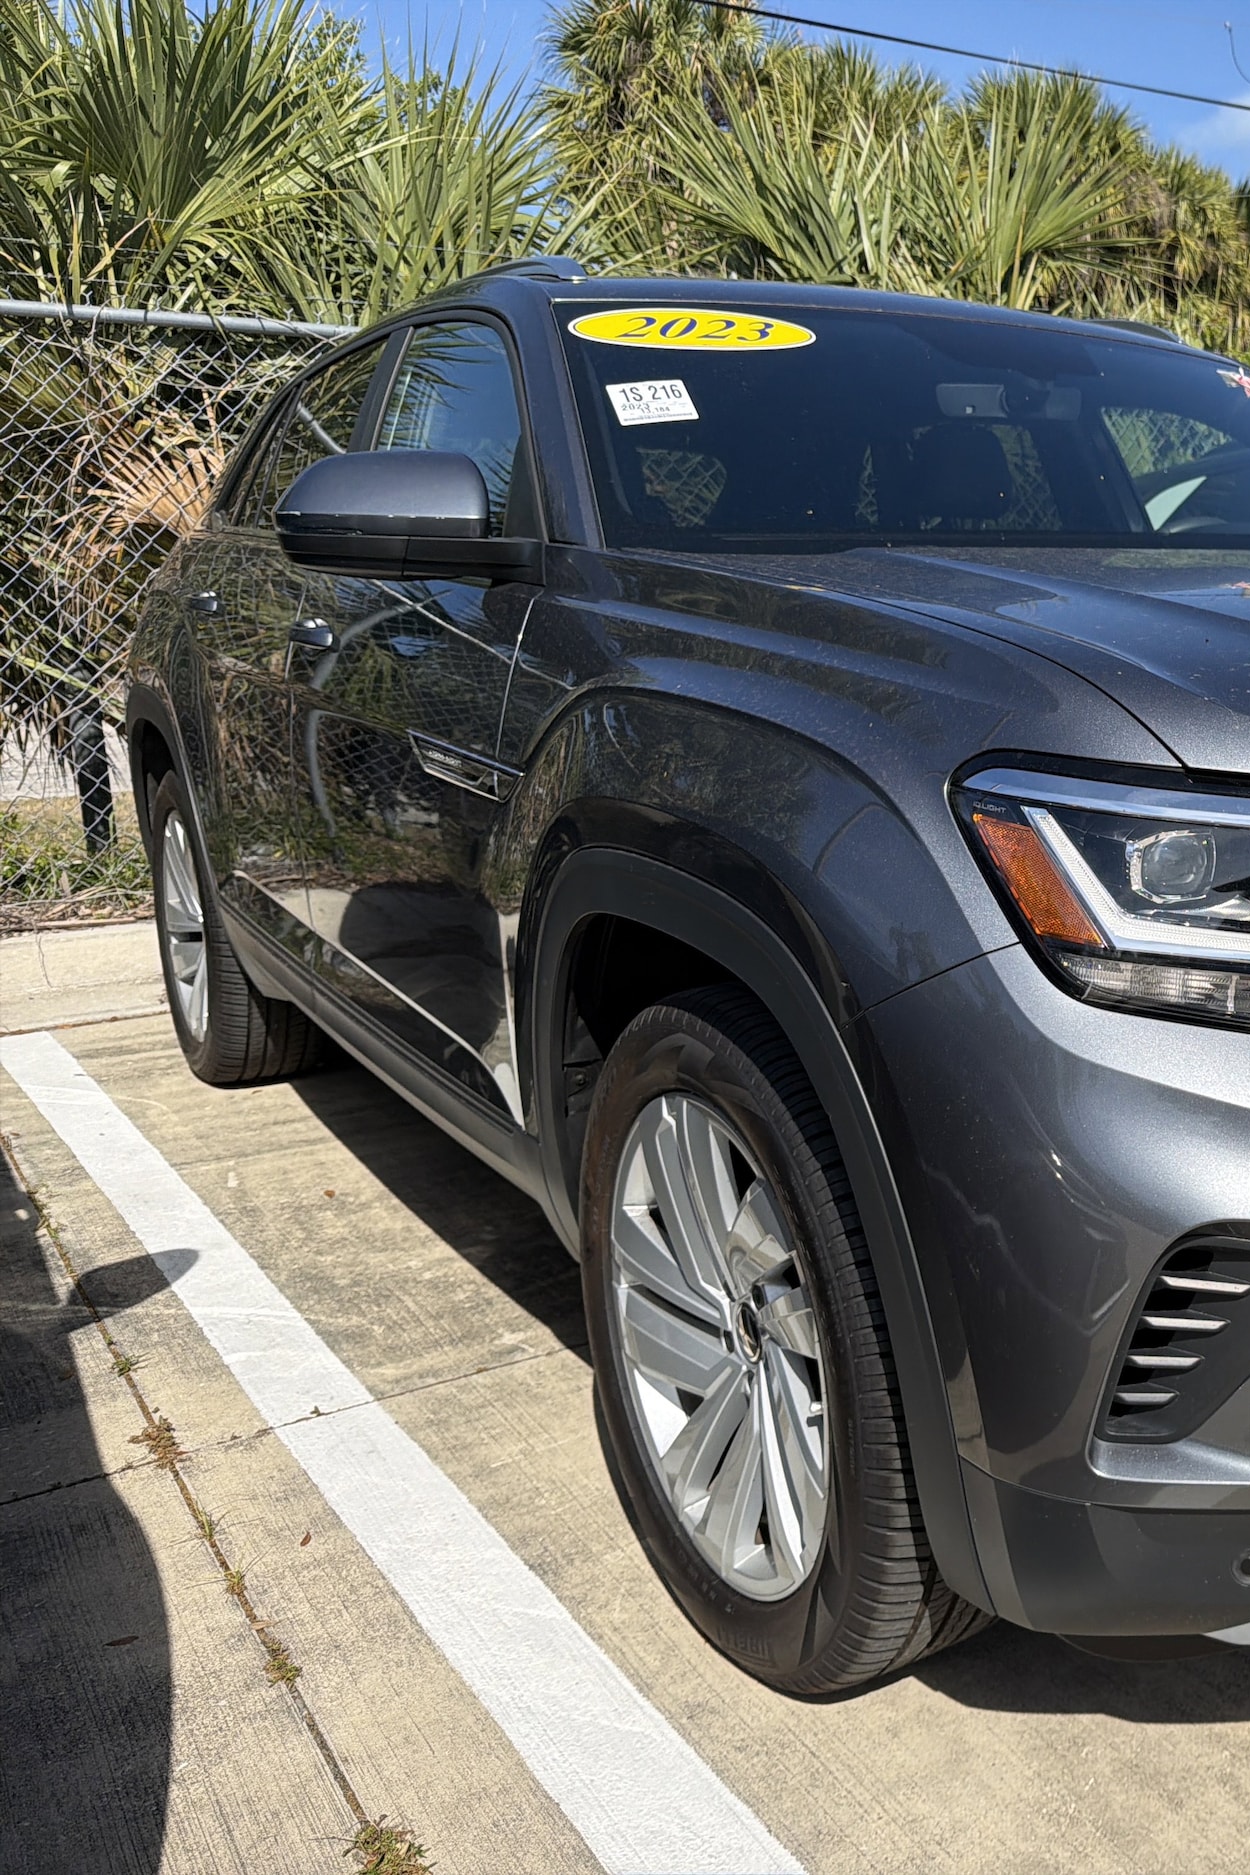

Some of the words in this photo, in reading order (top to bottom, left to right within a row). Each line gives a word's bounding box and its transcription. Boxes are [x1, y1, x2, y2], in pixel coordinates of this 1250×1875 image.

[615, 316, 774, 341] 2023
[619, 387, 643, 402] 1S
[648, 384, 682, 400] 216
